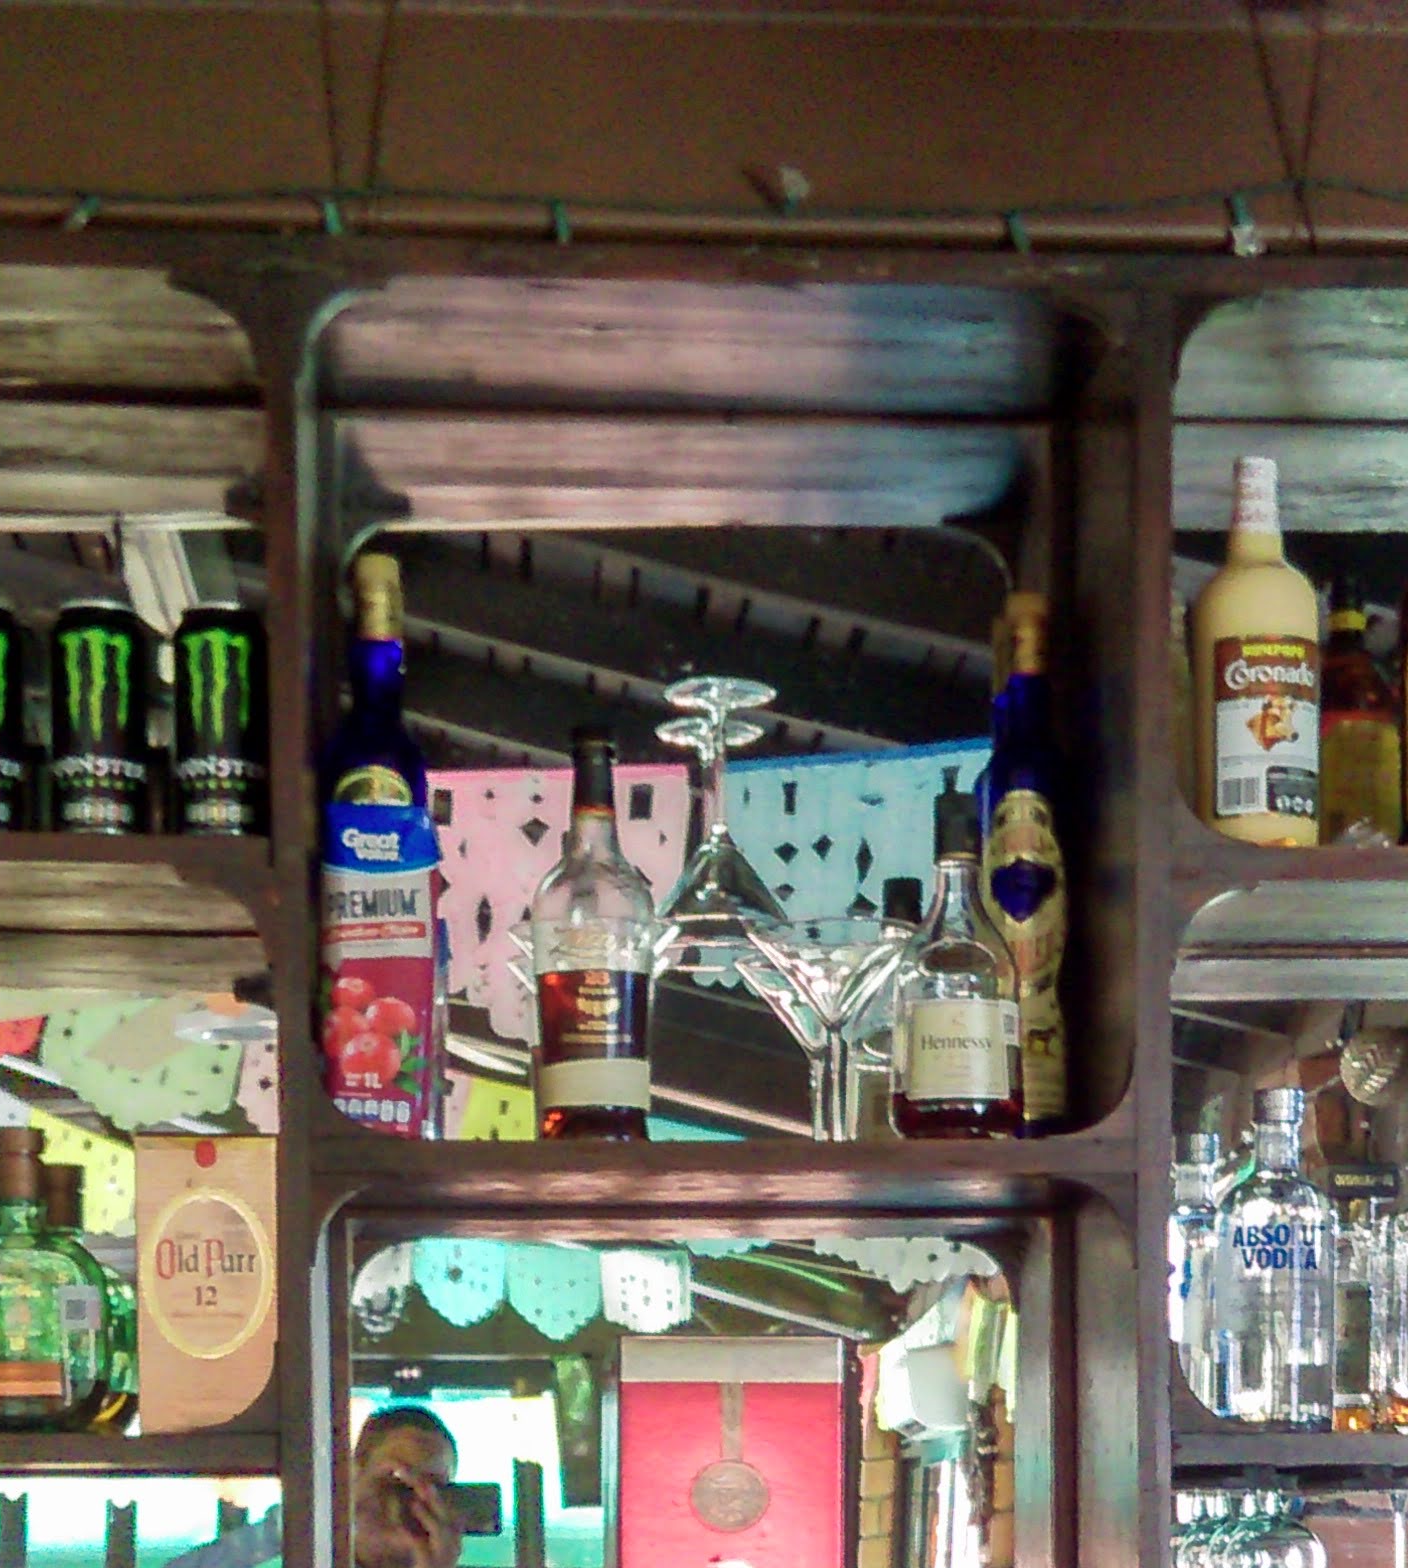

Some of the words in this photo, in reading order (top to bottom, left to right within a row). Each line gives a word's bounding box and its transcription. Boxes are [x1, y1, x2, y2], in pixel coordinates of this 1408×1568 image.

[1224, 658, 1315, 691] Coronado
[342, 828, 400, 851] Great
[920, 1034, 994, 1054] Hennessy
[1232, 1224, 1326, 1248] ABSOU
[154, 1237, 200, 1280] Old
[203, 1237, 257, 1279] Parr
[195, 1285, 218, 1307] 12
